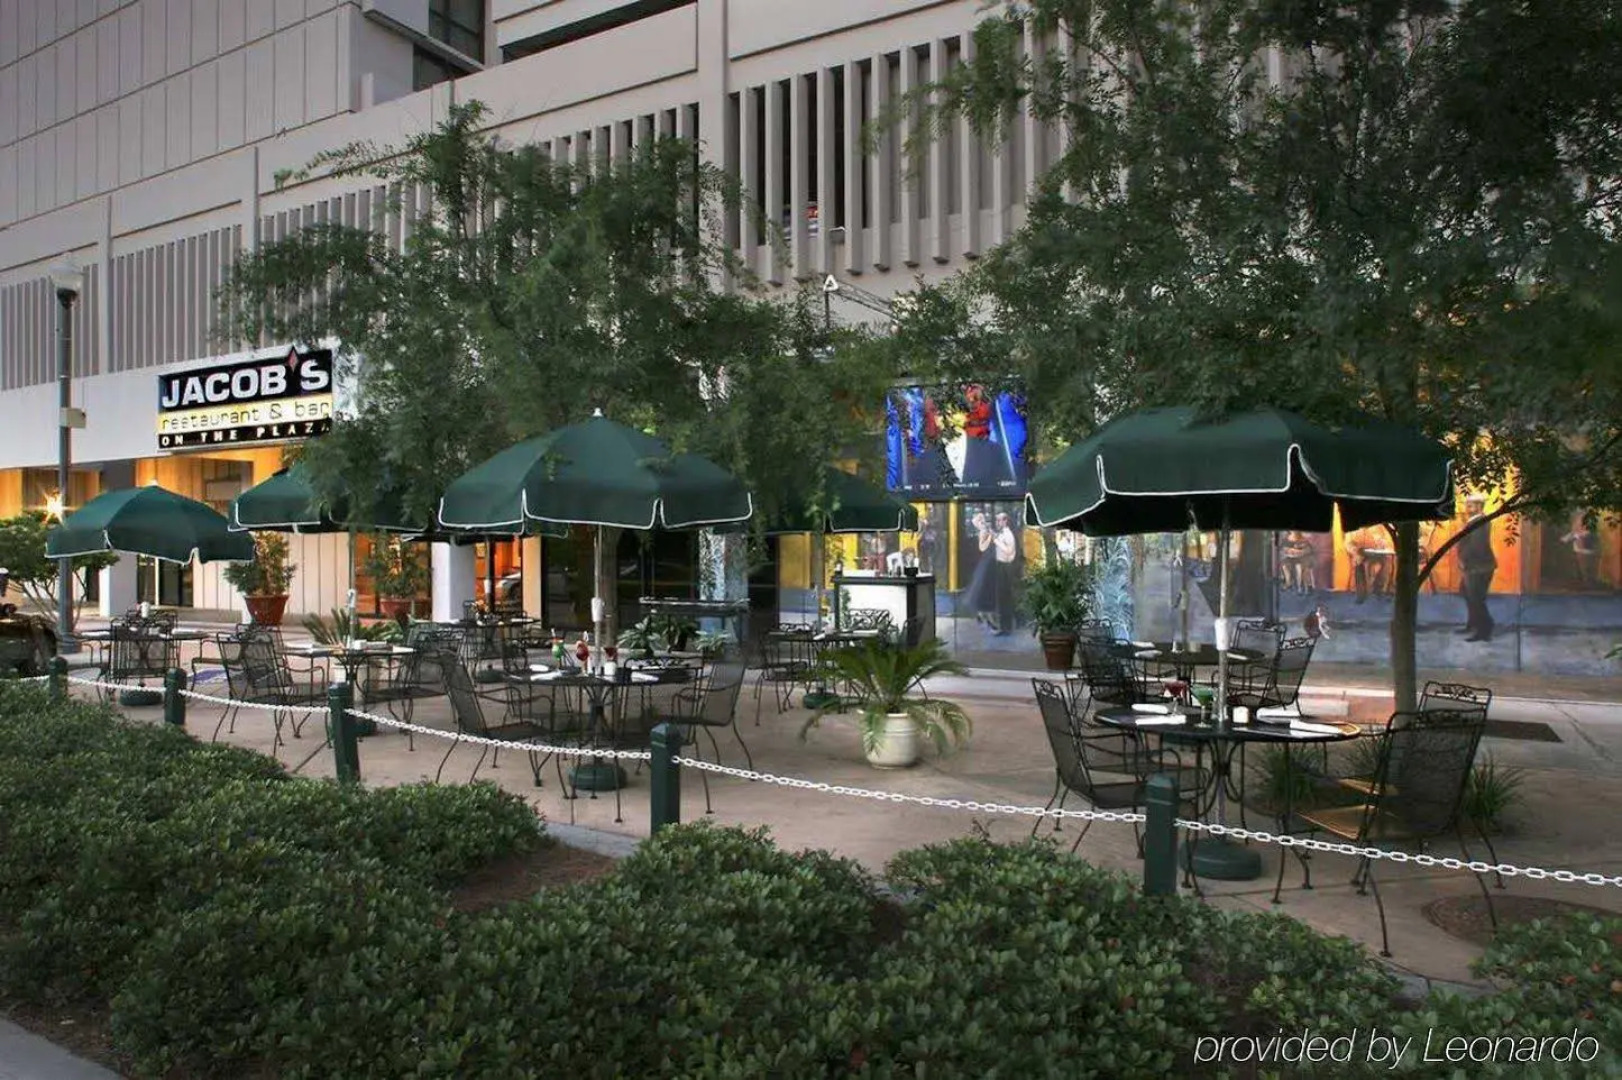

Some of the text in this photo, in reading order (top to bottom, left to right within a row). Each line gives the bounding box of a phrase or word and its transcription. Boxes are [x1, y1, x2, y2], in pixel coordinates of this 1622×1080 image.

[162, 348, 329, 408] JACOB'S
[162, 400, 329, 430] restaurant & bar
[161, 434, 184, 447] ON
[200, 429, 238, 443] THE
